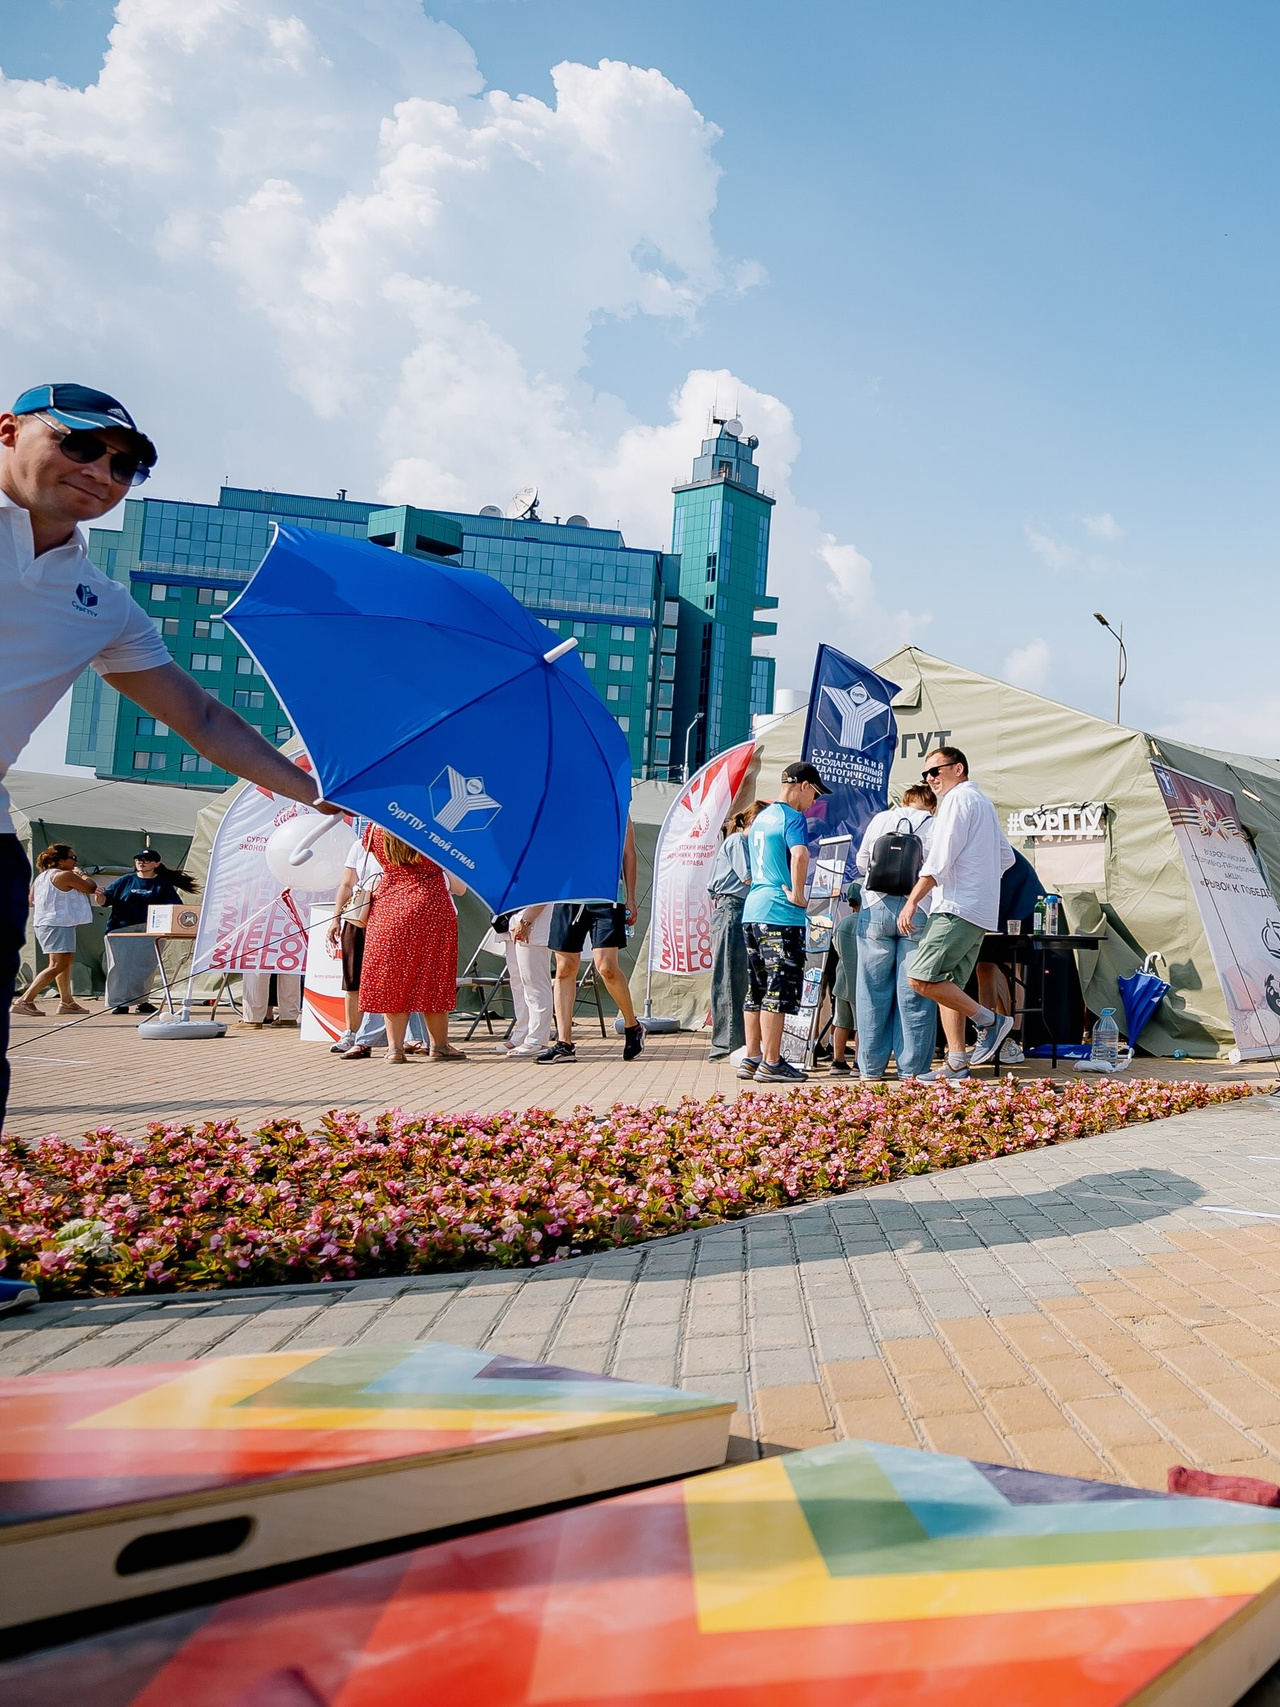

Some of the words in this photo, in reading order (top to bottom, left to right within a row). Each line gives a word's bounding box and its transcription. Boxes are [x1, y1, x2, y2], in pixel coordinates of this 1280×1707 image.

[896, 730, 952, 759] ГУТ
[811, 756, 884, 777] ГОСУДАРСТВЕННЫЙ
[812, 748, 884, 770] СУРГУТСКИЙ
[818, 773, 882, 792] ИВЕРСИТЕТ
[1007, 806, 1103, 833] #СурГПУ
[246, 835, 269, 843] СУРГУ
[387, 801, 426, 831] СурГПУ
[428, 831, 453, 852] твой
[449, 848, 476, 870] стиль
[209, 953, 307, 972] SIELO
